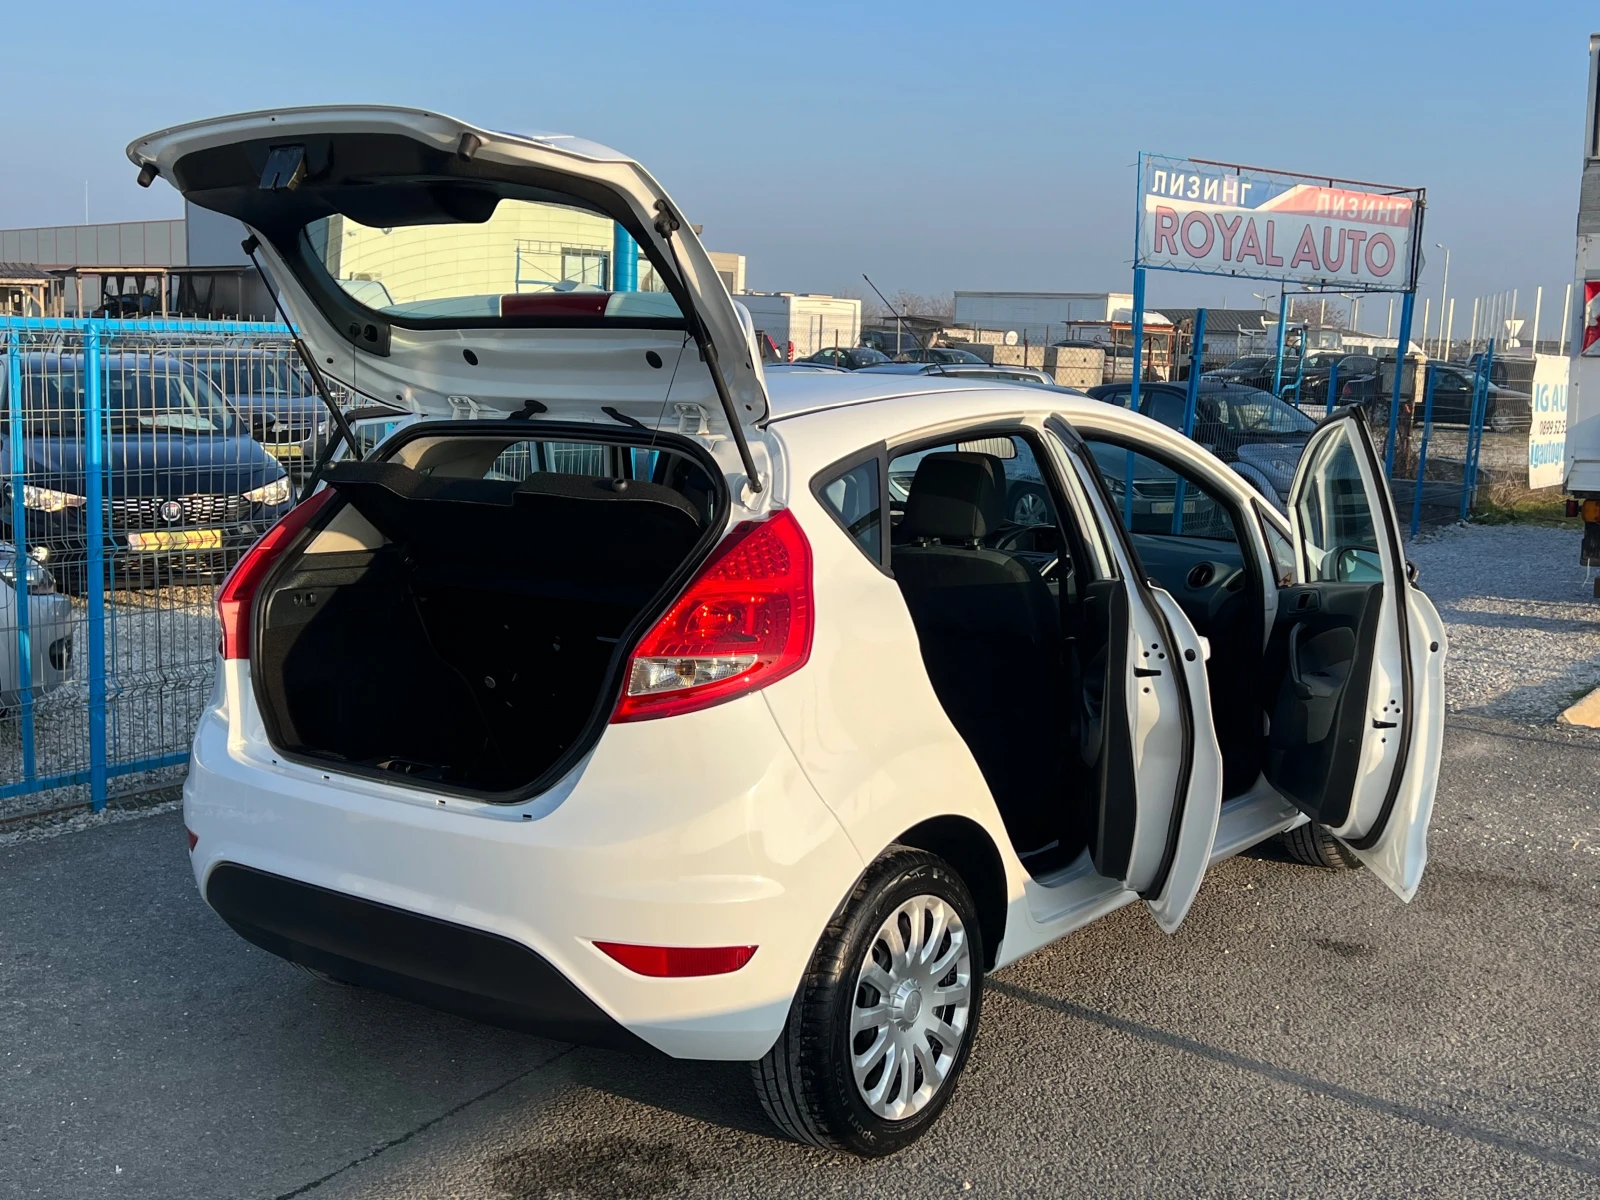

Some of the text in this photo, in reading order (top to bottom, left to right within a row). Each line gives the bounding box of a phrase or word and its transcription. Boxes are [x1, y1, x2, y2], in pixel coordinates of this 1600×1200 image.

[1151, 170, 1252, 205] ЛИЗИНГ
[1315, 193, 1408, 224] ЛИЗИНГ
[1154, 204, 1396, 278] ROYAL AUTO
[1534, 383, 1549, 412] IG
